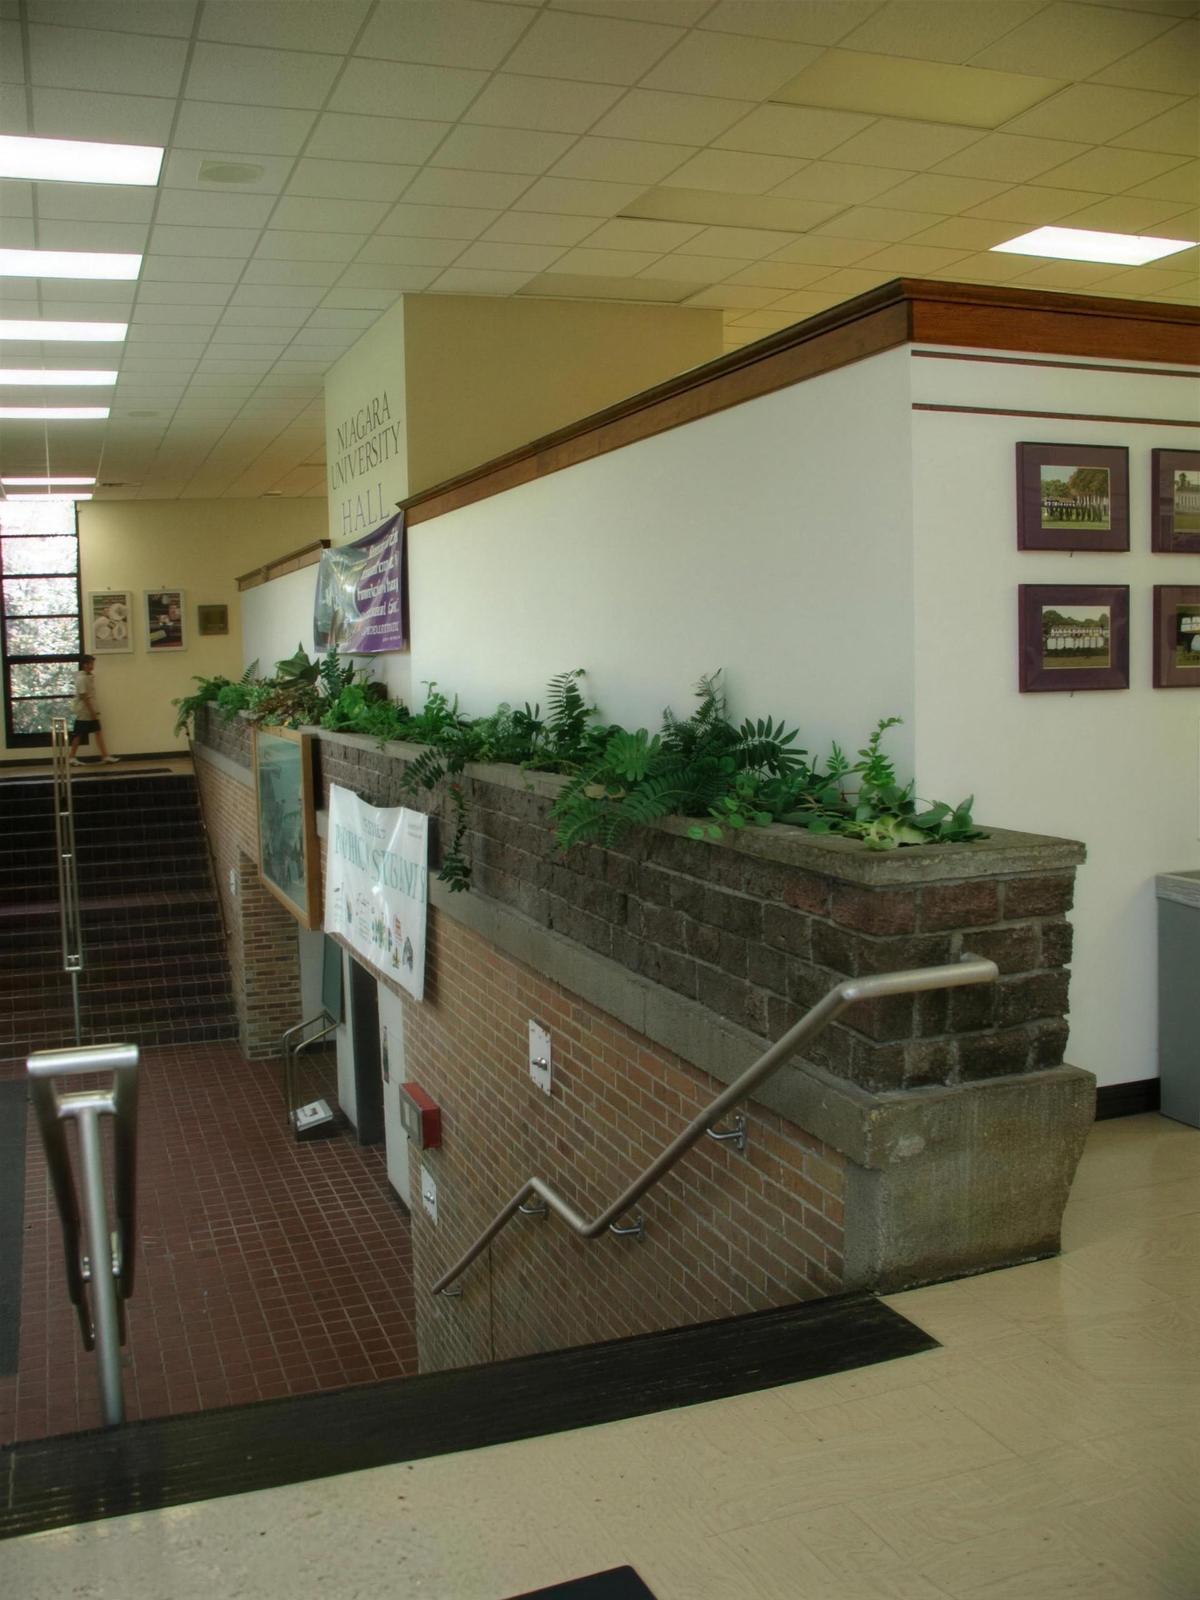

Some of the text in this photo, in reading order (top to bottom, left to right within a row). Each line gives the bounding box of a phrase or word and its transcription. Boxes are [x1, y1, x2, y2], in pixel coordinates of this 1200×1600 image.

[337, 389, 391, 454] NIAGARA
[331, 421, 400, 490] UNIVERSITY
[342, 482, 390, 536] HALL
